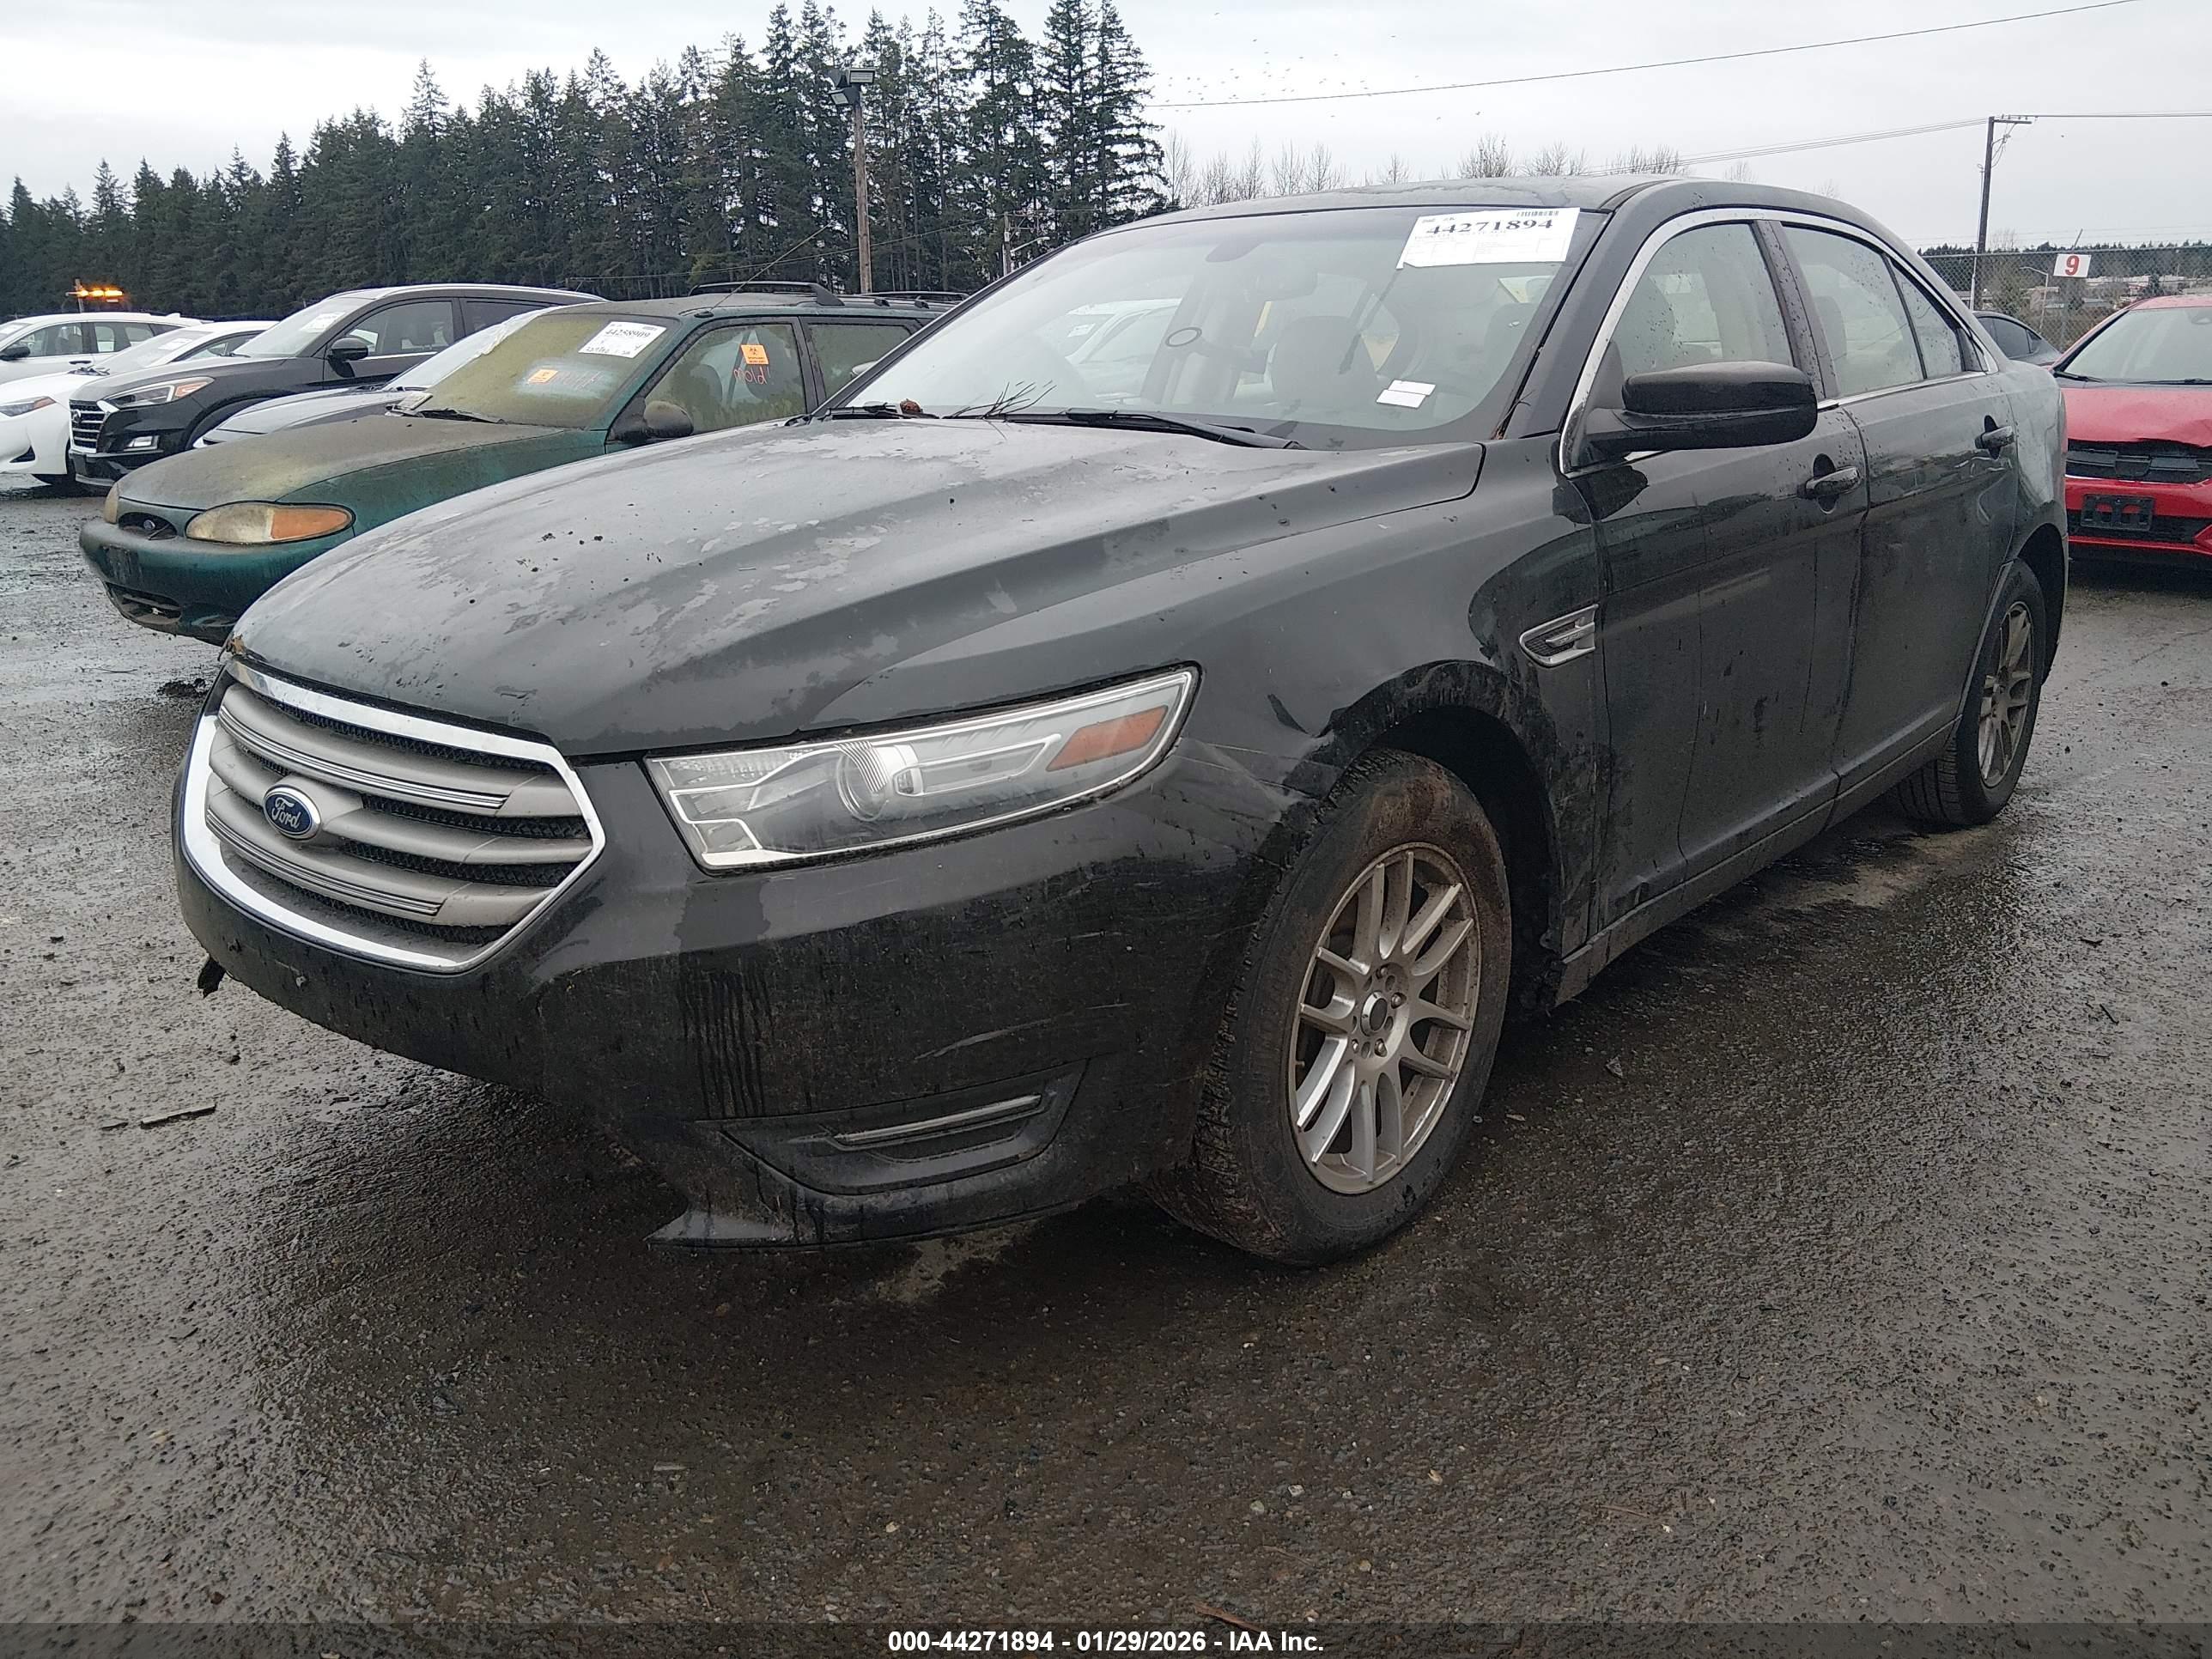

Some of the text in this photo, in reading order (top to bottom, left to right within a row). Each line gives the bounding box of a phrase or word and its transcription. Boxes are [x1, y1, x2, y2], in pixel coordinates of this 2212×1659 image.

[1426, 219, 1553, 234] 44271894
[2065, 255, 2080, 276] 9
[271, 797, 301, 830] Ford
